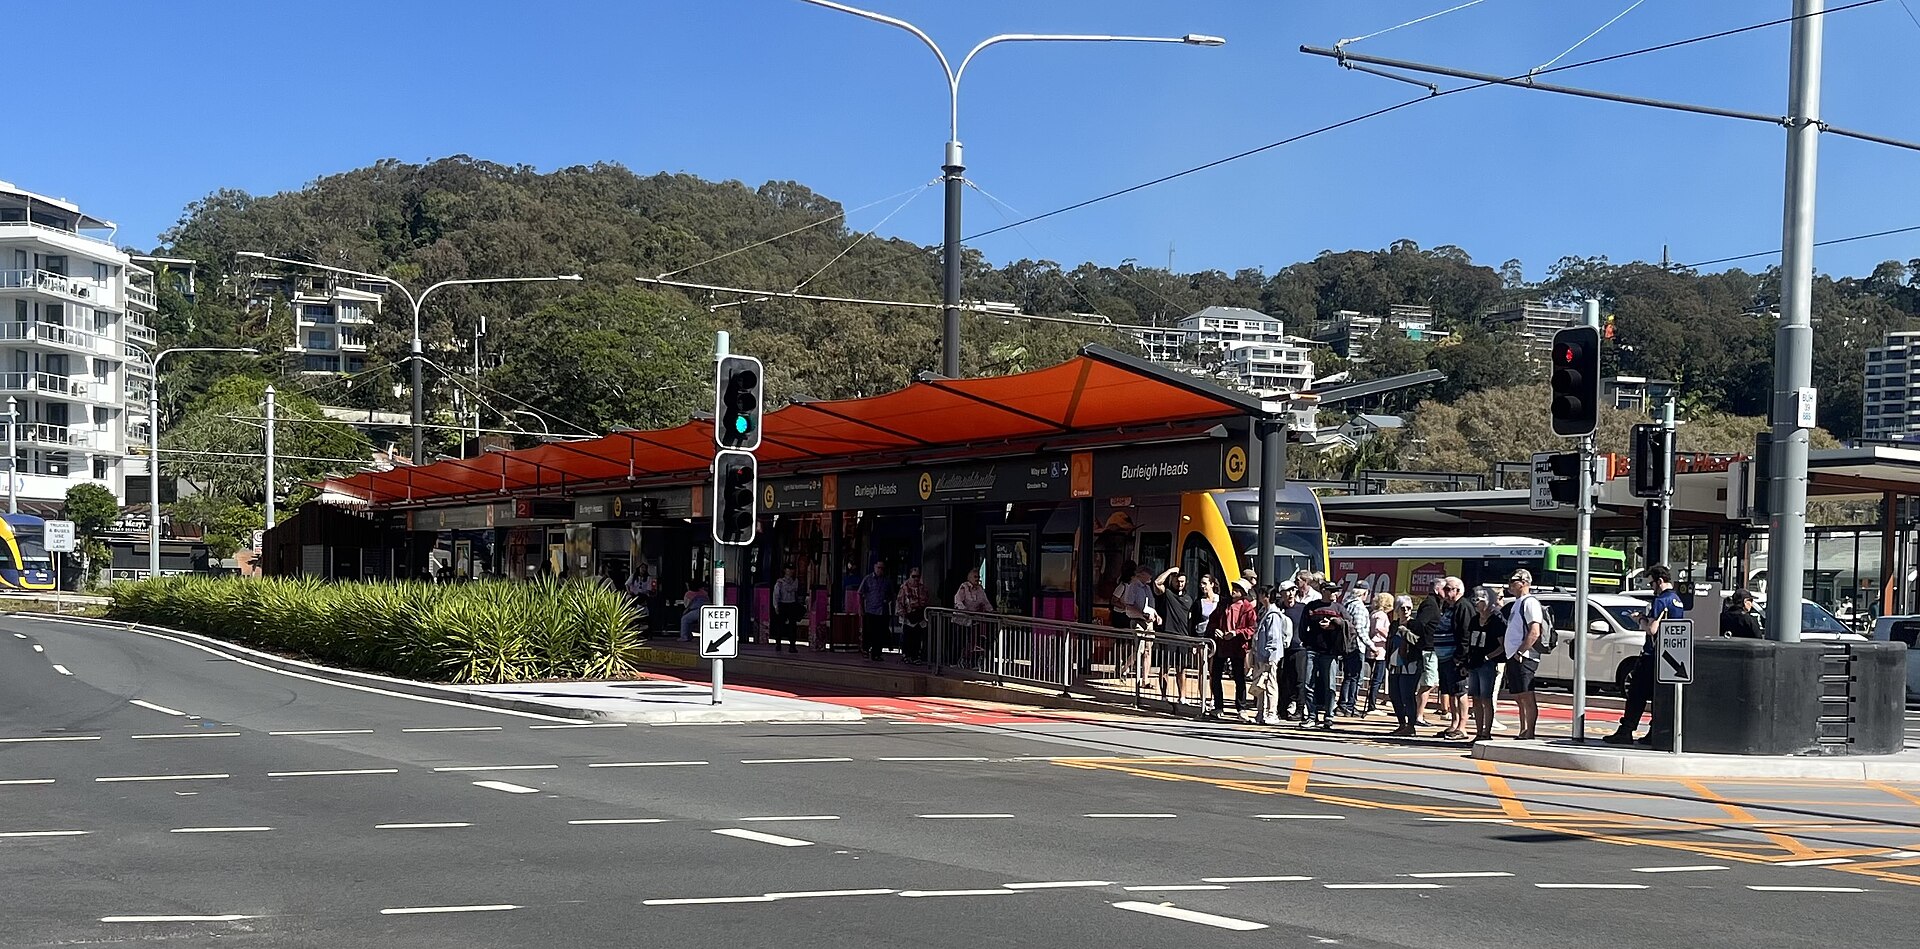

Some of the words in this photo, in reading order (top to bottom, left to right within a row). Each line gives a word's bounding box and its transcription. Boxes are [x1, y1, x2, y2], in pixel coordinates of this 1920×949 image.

[1121, 463, 1157, 480] Burleigh
[1159, 461, 1189, 477] Heads
[854, 485, 878, 499] Burleigh
[878, 483, 897, 496] Heads
[1535, 499, 1554, 507] TRAMS
[518, 503, 526, 515] 2
[1339, 561, 1354, 571] FROM
[707, 610, 731, 620] KEEP
[709, 620, 729, 630] LEFT
[1664, 625, 1687, 636] KEEP
[1663, 637, 1688, 649] RIGHT
